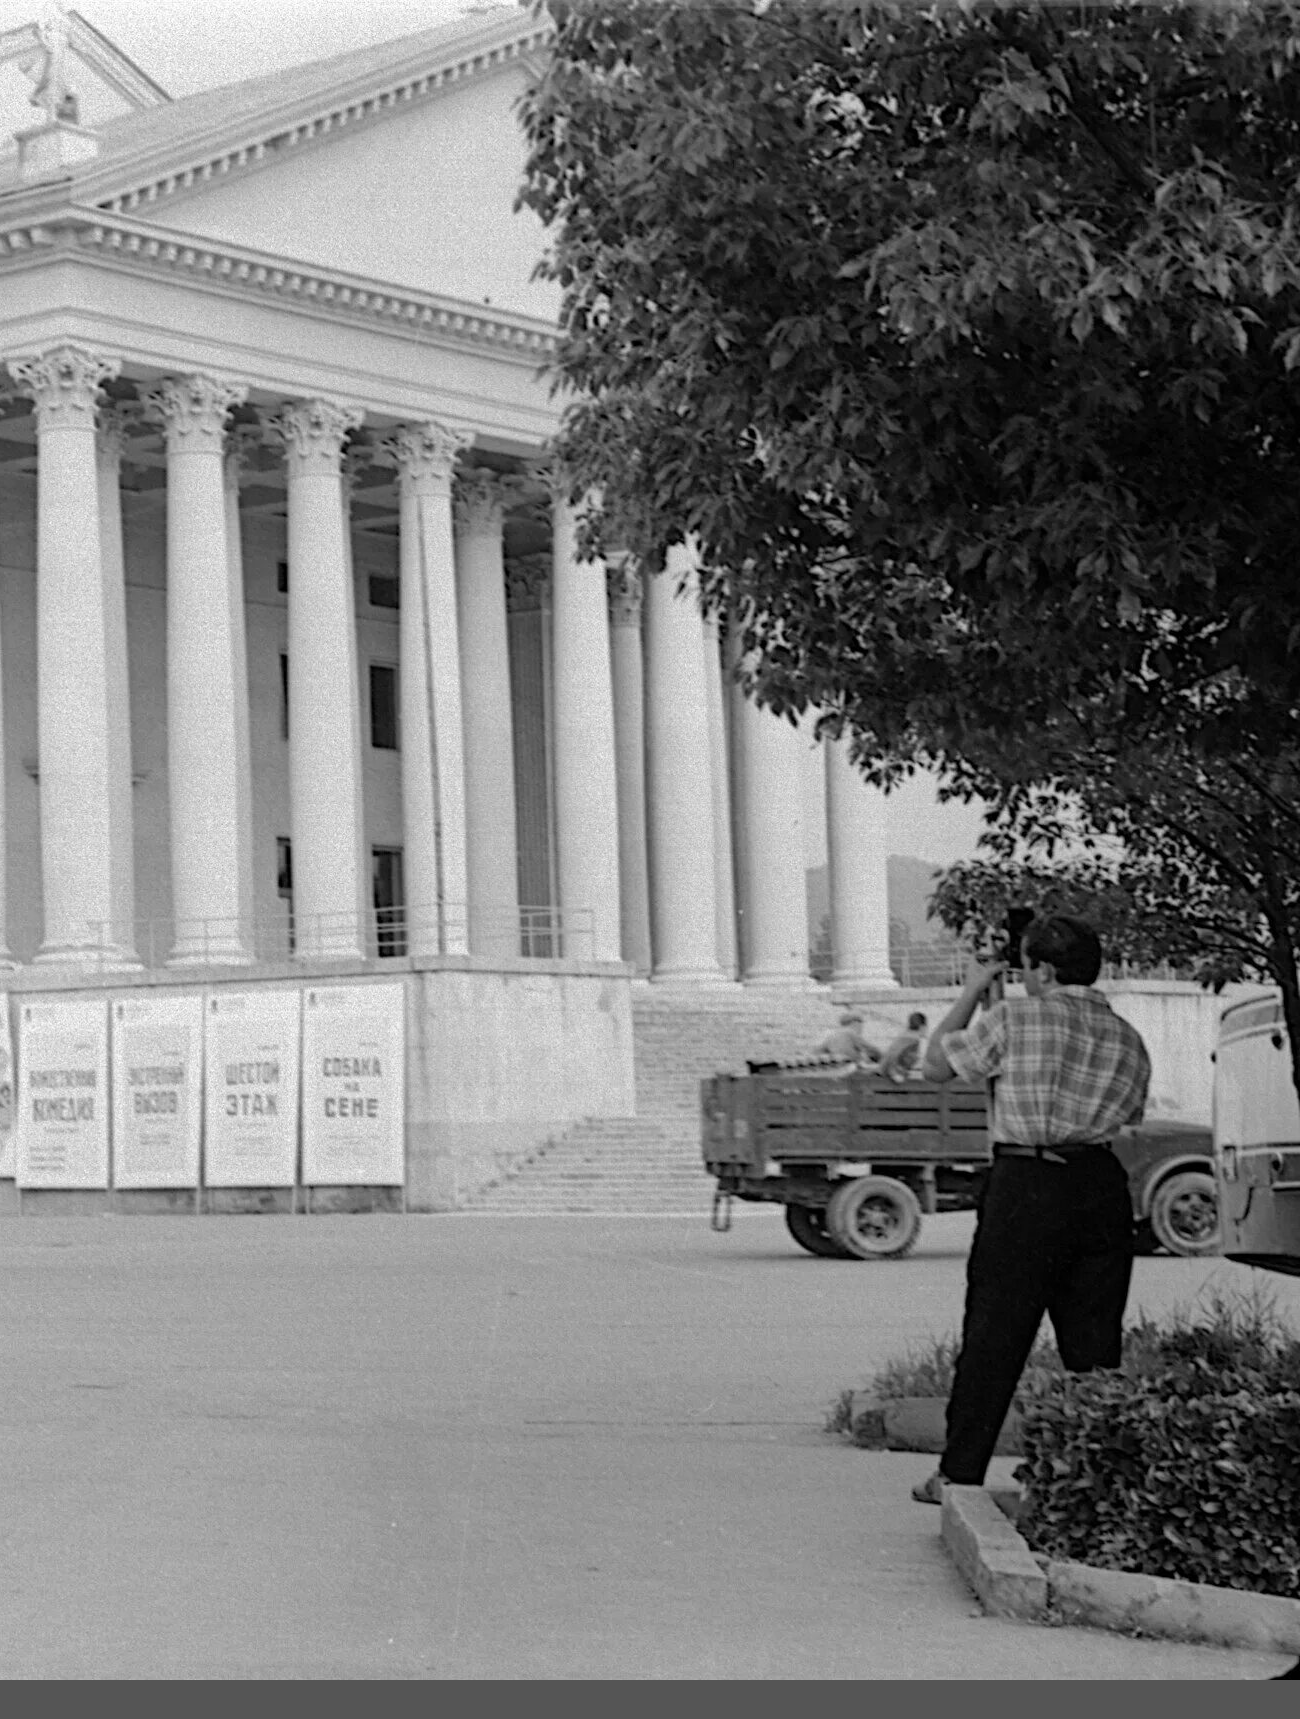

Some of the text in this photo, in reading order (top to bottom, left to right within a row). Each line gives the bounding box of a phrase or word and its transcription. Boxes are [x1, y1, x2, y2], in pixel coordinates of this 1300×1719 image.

[226, 1059, 279, 1085] ШЕСТОЙ
[323, 1057, 382, 1077] СОБАКА
[33, 1097, 94, 1122] КОМЕДИЯ
[226, 1094, 277, 1116] ЭТАЖ
[325, 1097, 379, 1118] СЕНЕ
